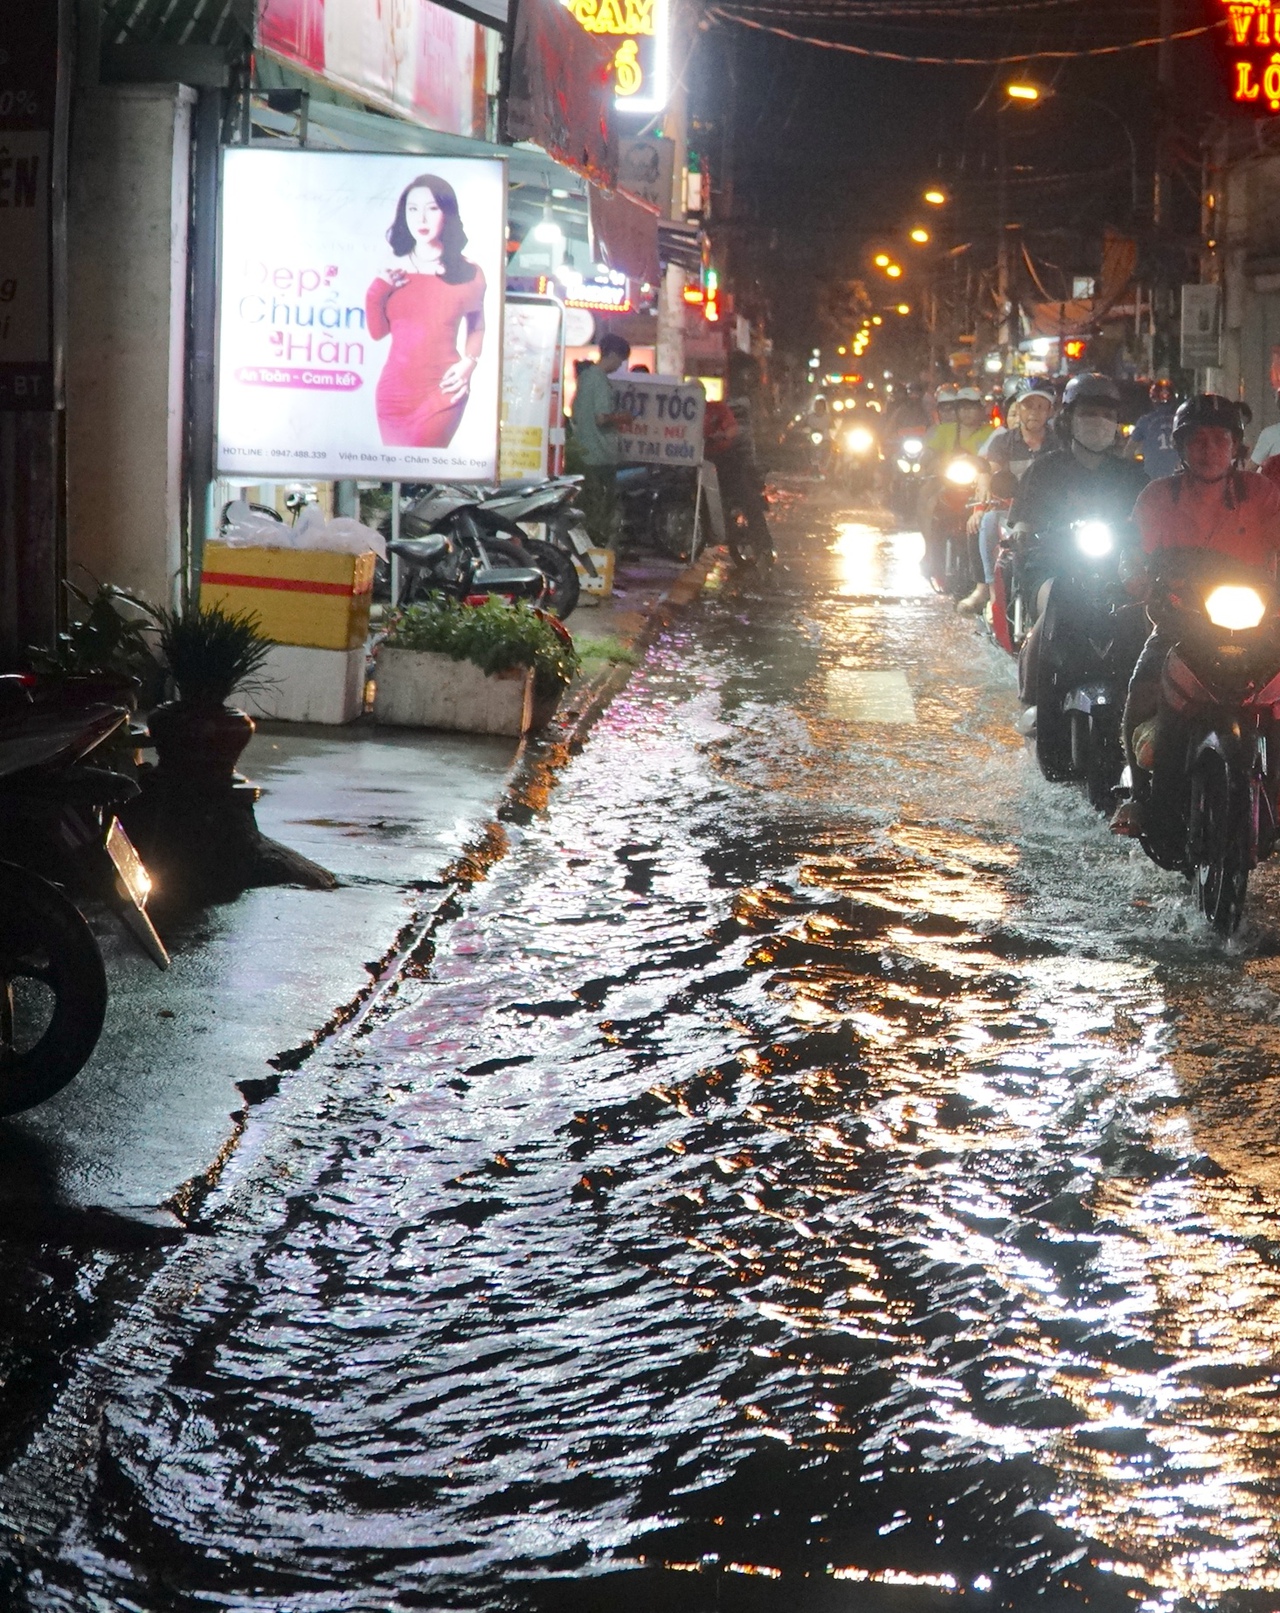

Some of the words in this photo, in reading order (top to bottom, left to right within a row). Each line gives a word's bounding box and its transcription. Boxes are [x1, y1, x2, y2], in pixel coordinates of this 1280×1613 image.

[239, 290, 365, 329] Chuẩn
[287, 332, 365, 365] Hàn
[302, 371, 333, 385] Cam
[656, 388, 696, 420] TÓC
[222, 446, 262, 457] HOTLINE
[339, 450, 358, 461] Viện
